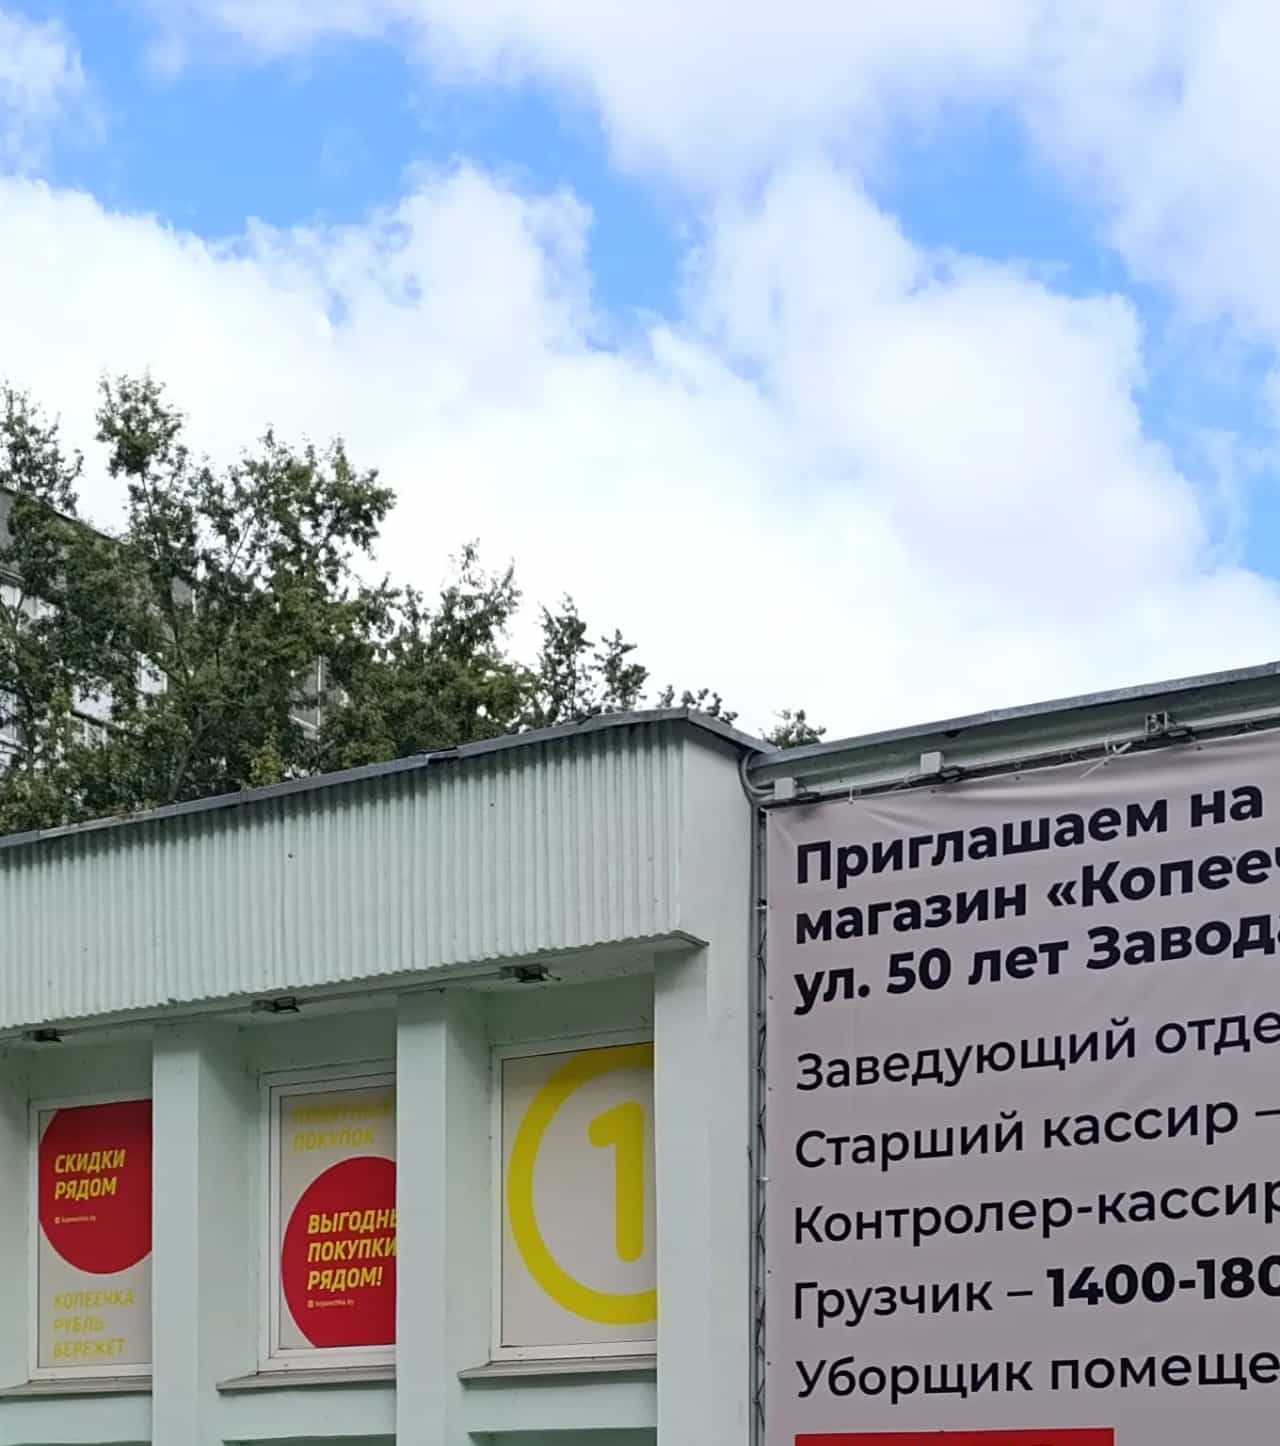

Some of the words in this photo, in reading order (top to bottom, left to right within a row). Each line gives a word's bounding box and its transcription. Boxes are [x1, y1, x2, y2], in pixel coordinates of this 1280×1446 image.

[796, 798, 1169, 890] Приглашаем
[1190, 785, 1263, 828] на
[796, 883, 1027, 945] магазин
[793, 967, 871, 1016] ул.
[886, 947, 952, 995] 50
[967, 940, 1069, 986] лет
[796, 1016, 1136, 1091] Заведующий
[54, 1148, 126, 1174] СКИДКИ
[795, 1109, 1023, 1173] Старший
[1043, 1101, 1239, 1149] кассир
[54, 1176, 117, 1201] РЯДОМ
[308, 1236, 397, 1262] ПОКУПКИ
[308, 1266, 383, 1292] РЯДОМ!
[794, 1280, 993, 1329] Грузчик
[795, 1355, 1034, 1405] Уборщик
